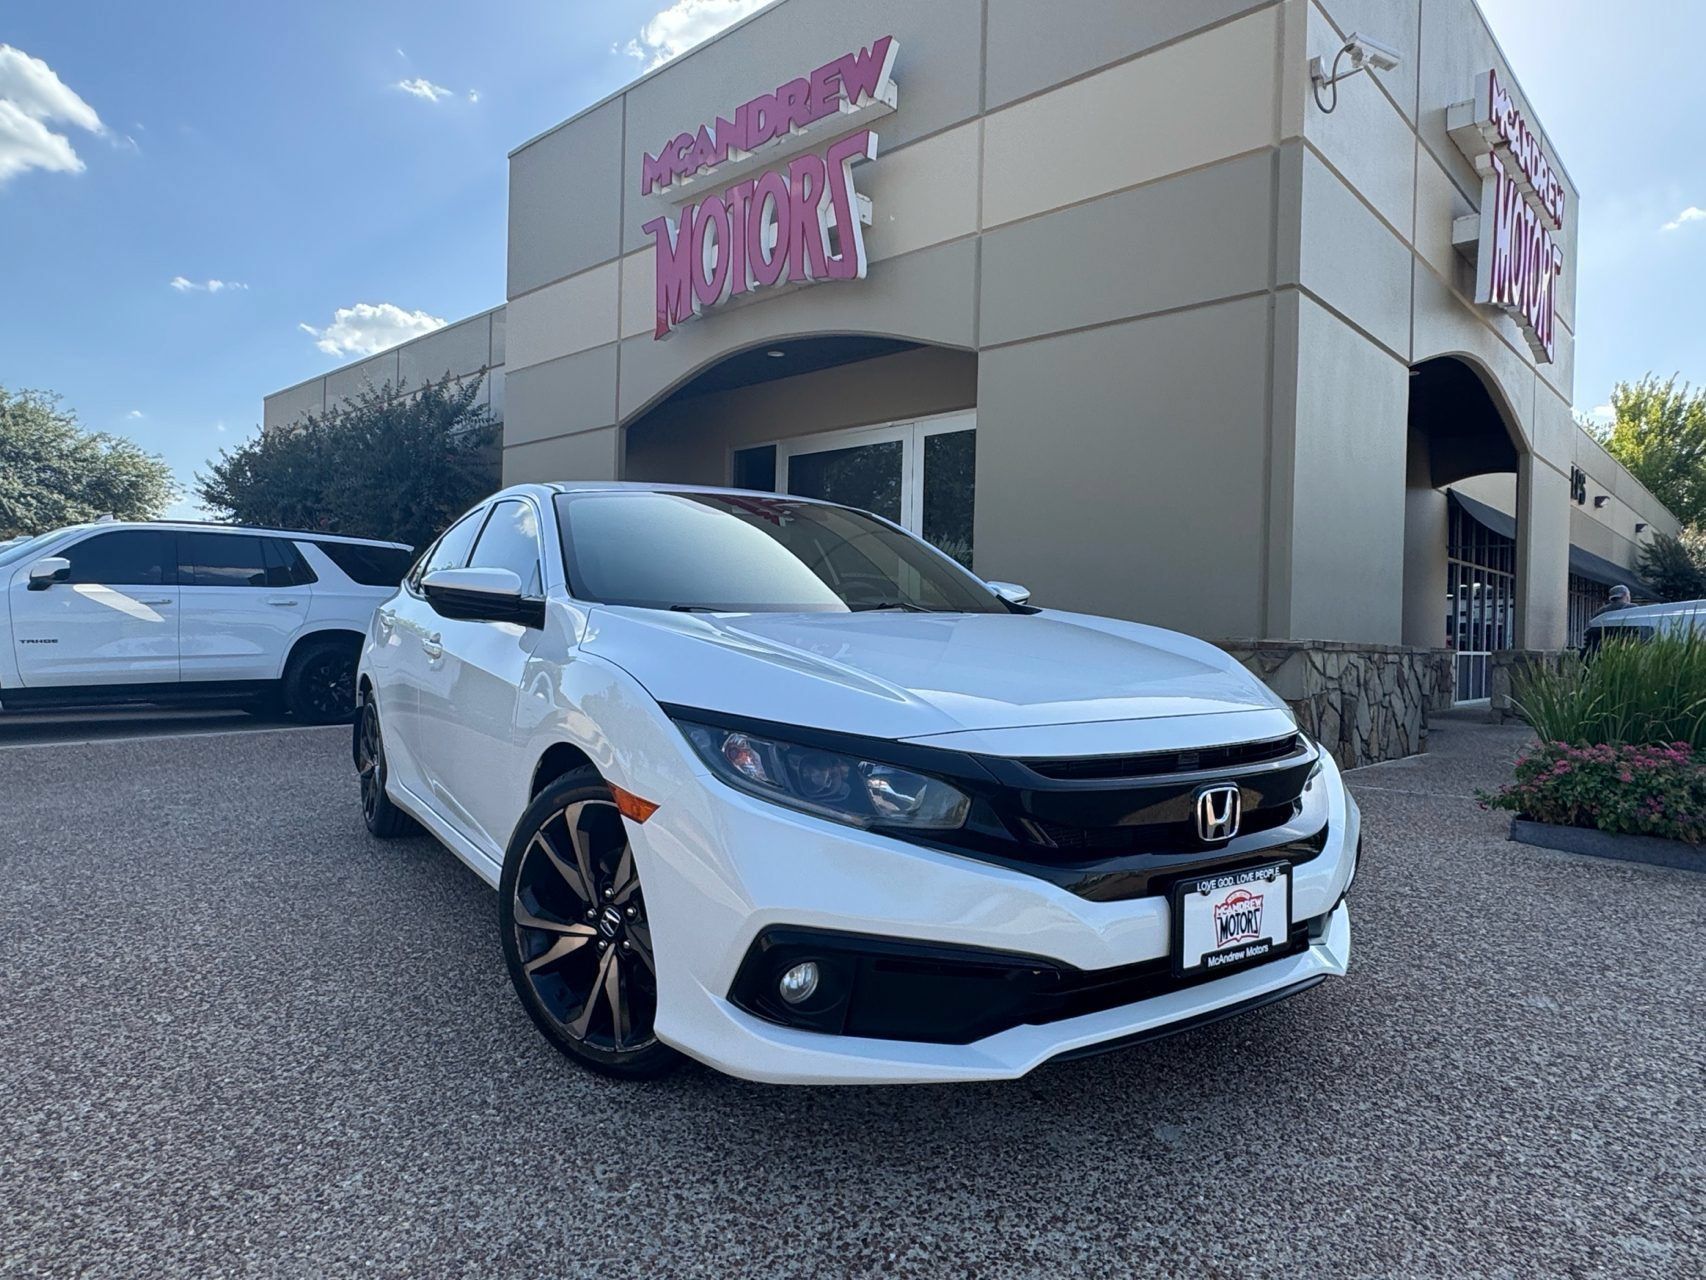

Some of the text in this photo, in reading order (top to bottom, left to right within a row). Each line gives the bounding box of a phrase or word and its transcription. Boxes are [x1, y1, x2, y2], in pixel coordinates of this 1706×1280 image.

[641, 129, 871, 340] MOTORS
[1197, 880, 1217, 892] LOVE
[1236, 872, 1255, 884] LOVE
[1216, 908, 1260, 943] MOTORS
[1207, 943, 1269, 968] McAndrew Motors
